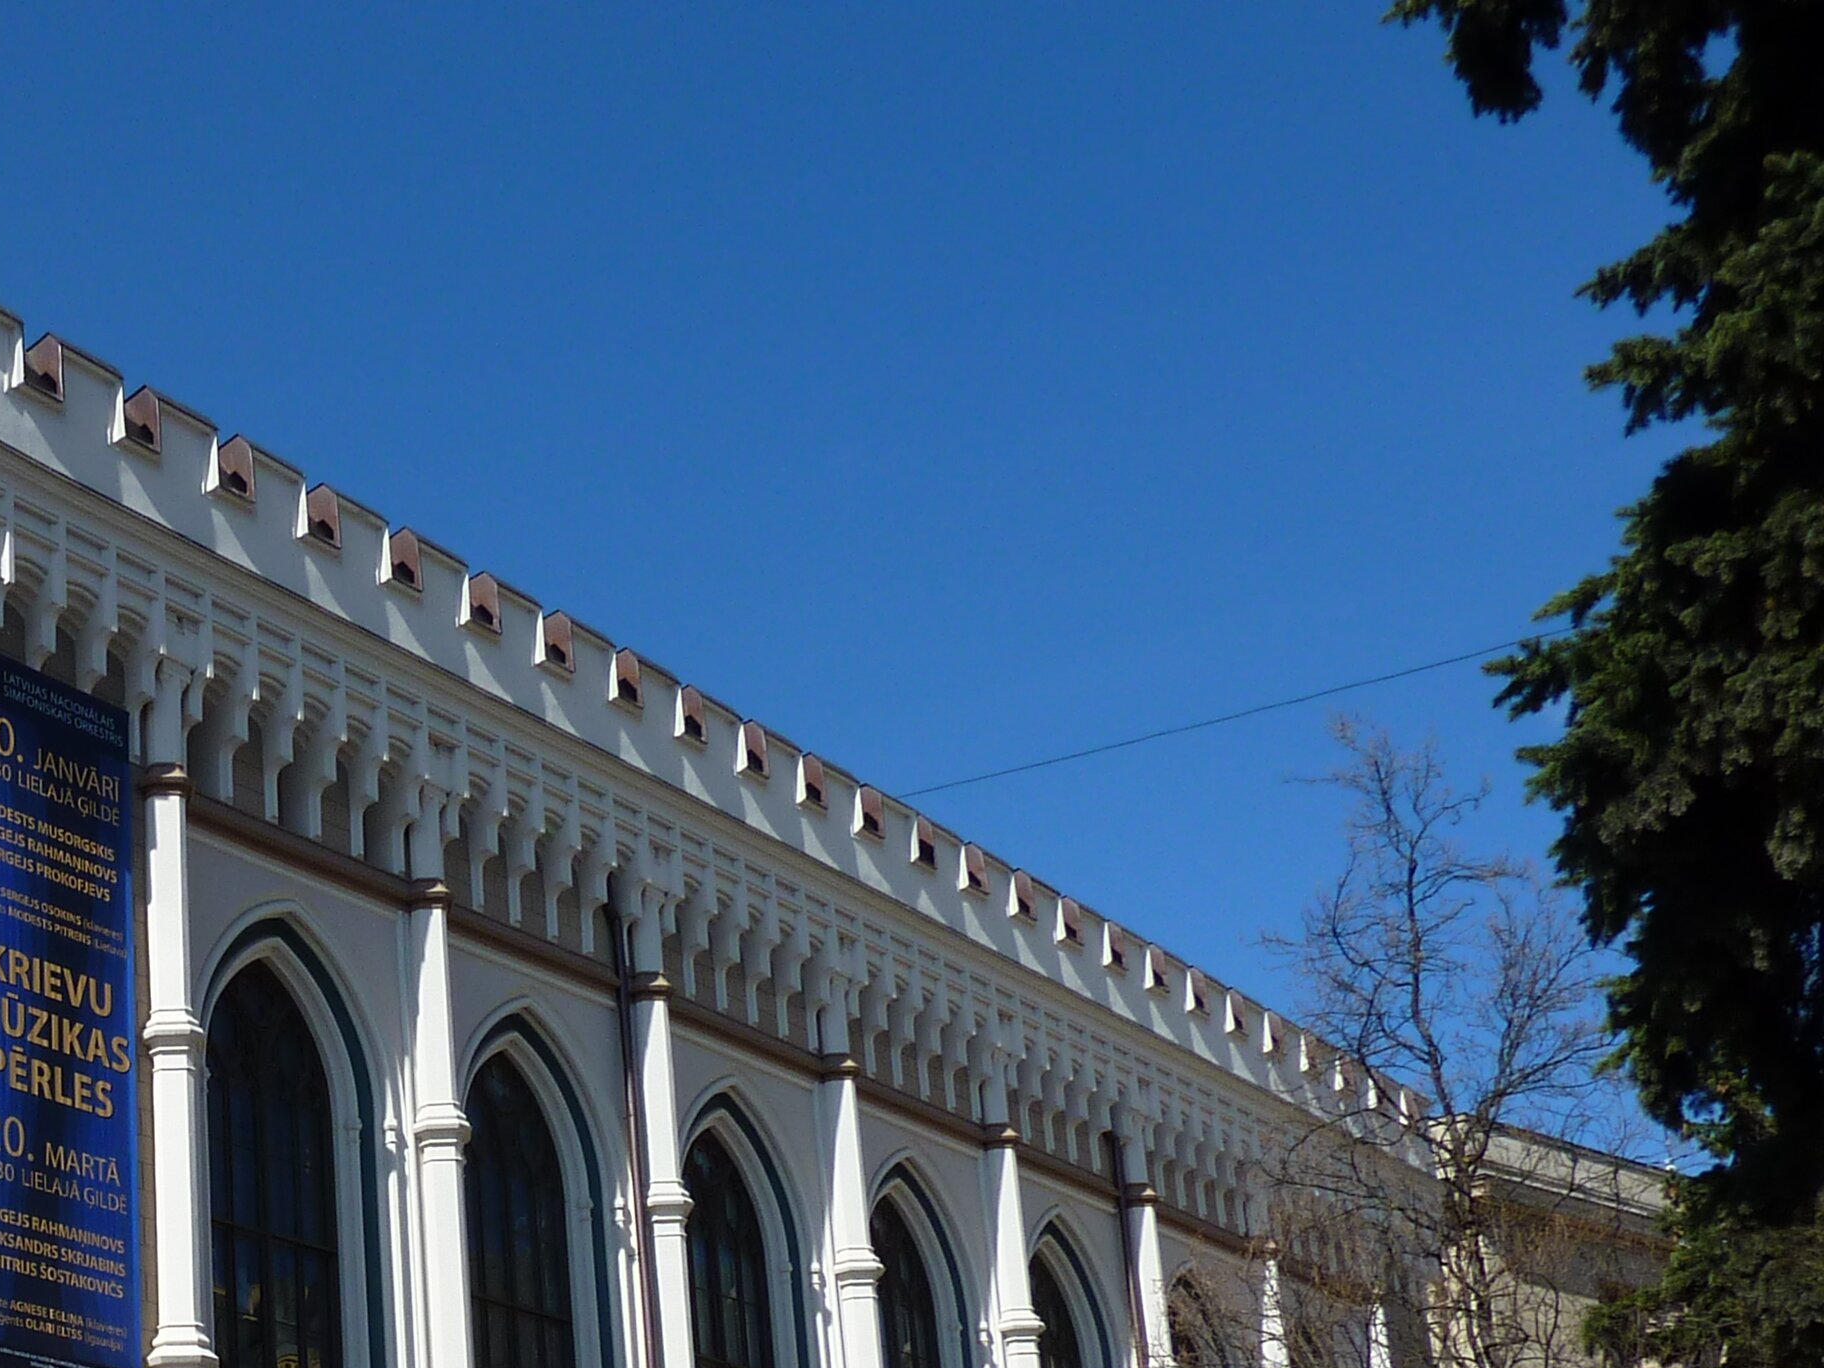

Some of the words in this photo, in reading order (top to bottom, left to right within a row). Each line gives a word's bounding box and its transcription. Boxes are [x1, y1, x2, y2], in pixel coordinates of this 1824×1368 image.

[3, 671, 48, 700] LATVIJAS
[3, 685, 73, 725] SIMFONISKAIS
[75, 717, 124, 748] ORKESTRIS
[33, 747, 121, 803] JANVĀRĪ
[17, 770, 75, 809] LIELAJĀ
[77, 796, 121, 827] ĢILDĒ
[37, 820, 116, 862] MUSORGSKIS
[36, 862, 111, 902] PROKOFJEVS
[0, 886, 40, 911] SERGEJS
[41, 903, 82, 926] OSOKINS
[8, 906, 53, 932] MODESTS
[45, 1141, 121, 1188] MARTĀ
[21, 1168, 81, 1202] LIELAJĀ
[83, 1187, 129, 1216] ĢILDĒ
[31, 1216, 125, 1254] RAHMAŅINOVS
[39, 1261, 125, 1299] ŠOSTAKOVIČS
[61, 1247, 126, 1278] SKRJABINS
[10, 1300, 48, 1319] AGNESE
[25, 1318, 56, 1335] OLARI
